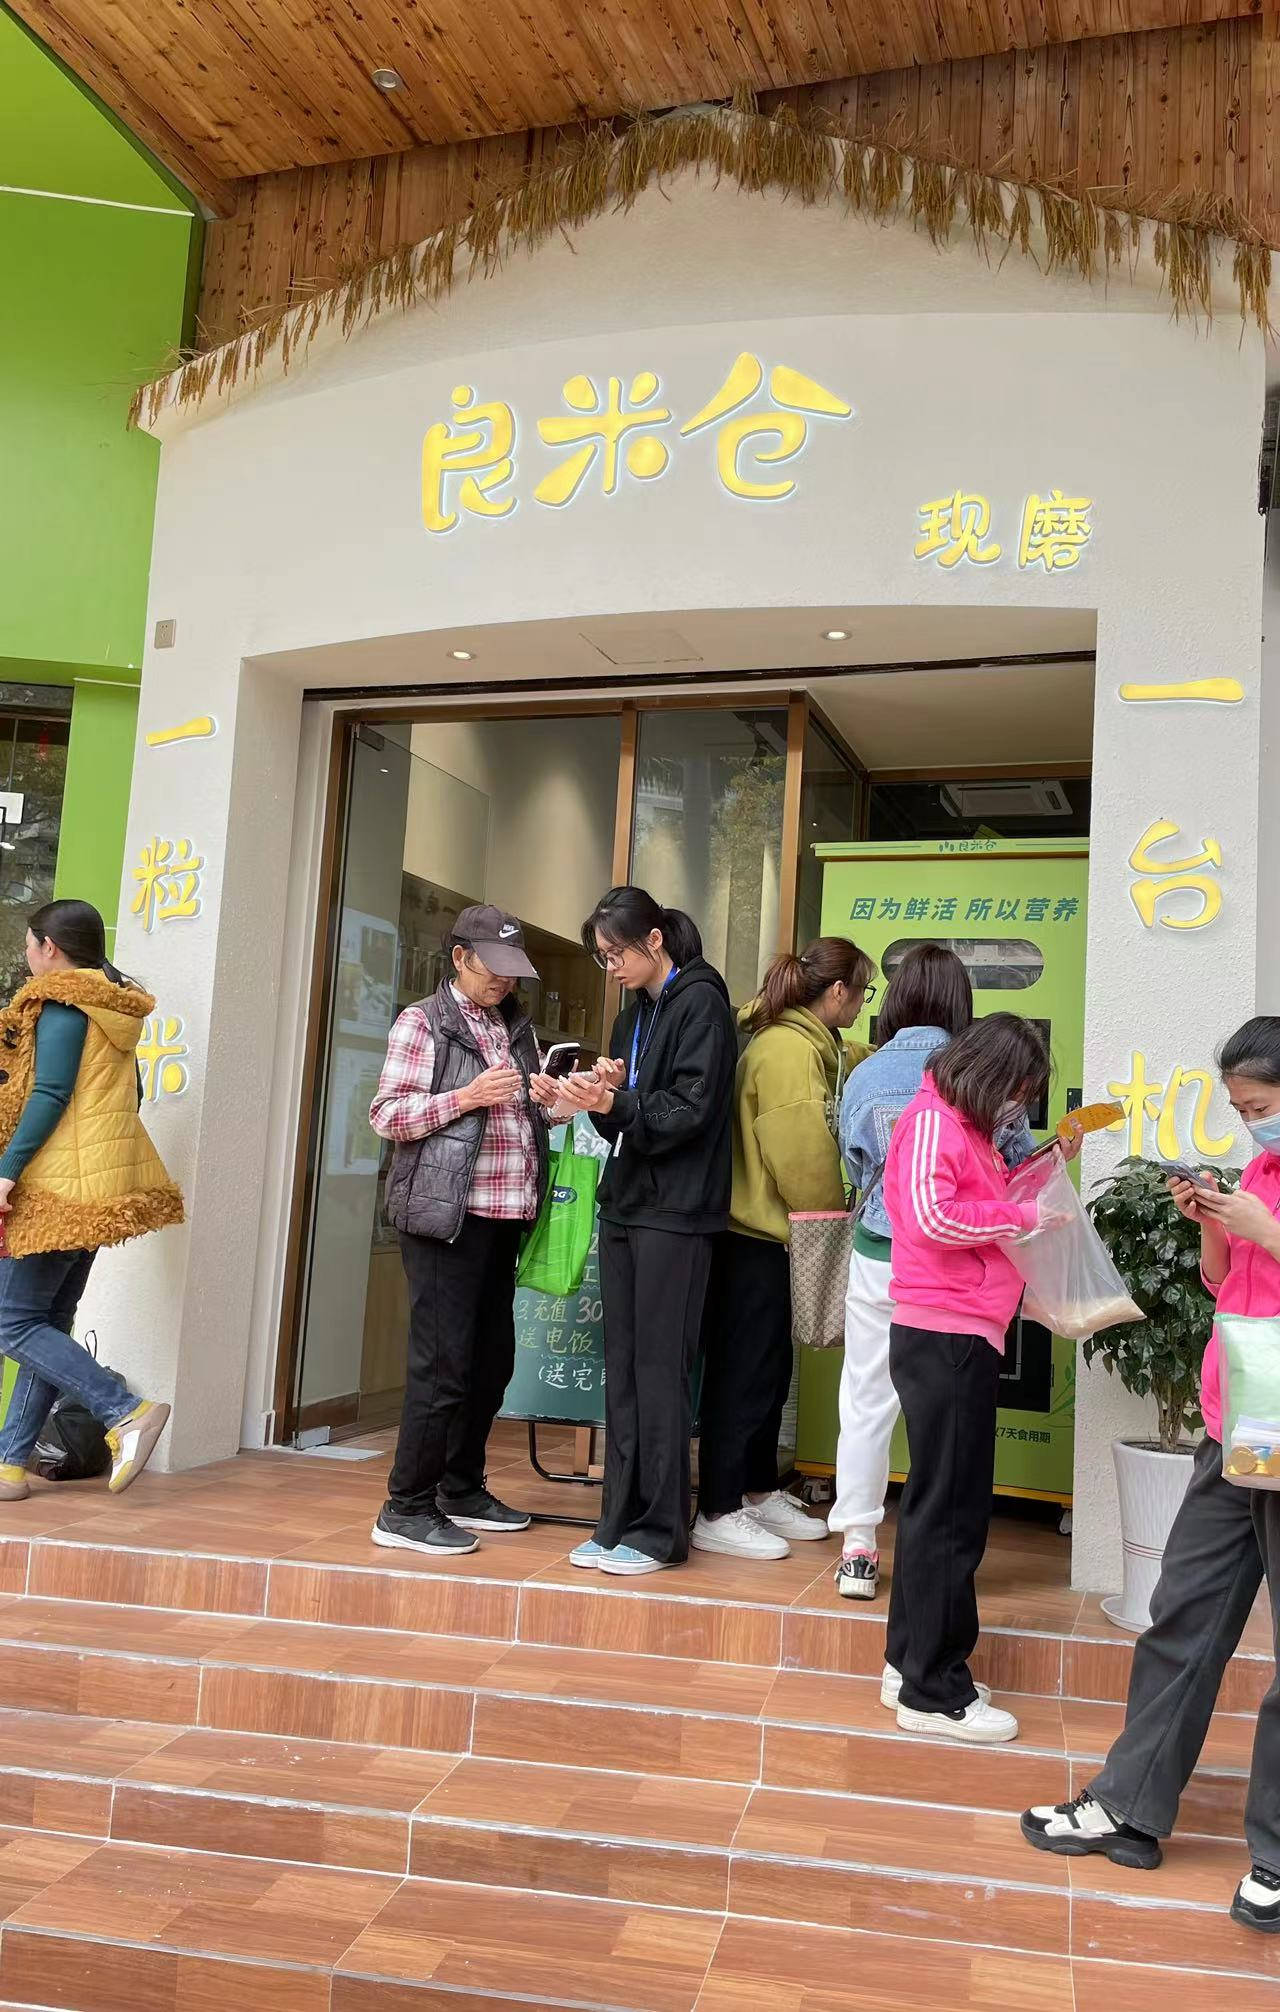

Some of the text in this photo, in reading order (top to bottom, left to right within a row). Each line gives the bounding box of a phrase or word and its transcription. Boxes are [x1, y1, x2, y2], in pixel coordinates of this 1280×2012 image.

[421, 351, 852, 533] 良米仓
[914, 488, 1093, 572] 现磨
[850, 897, 1079, 922] 因为鲜活 所以营养
